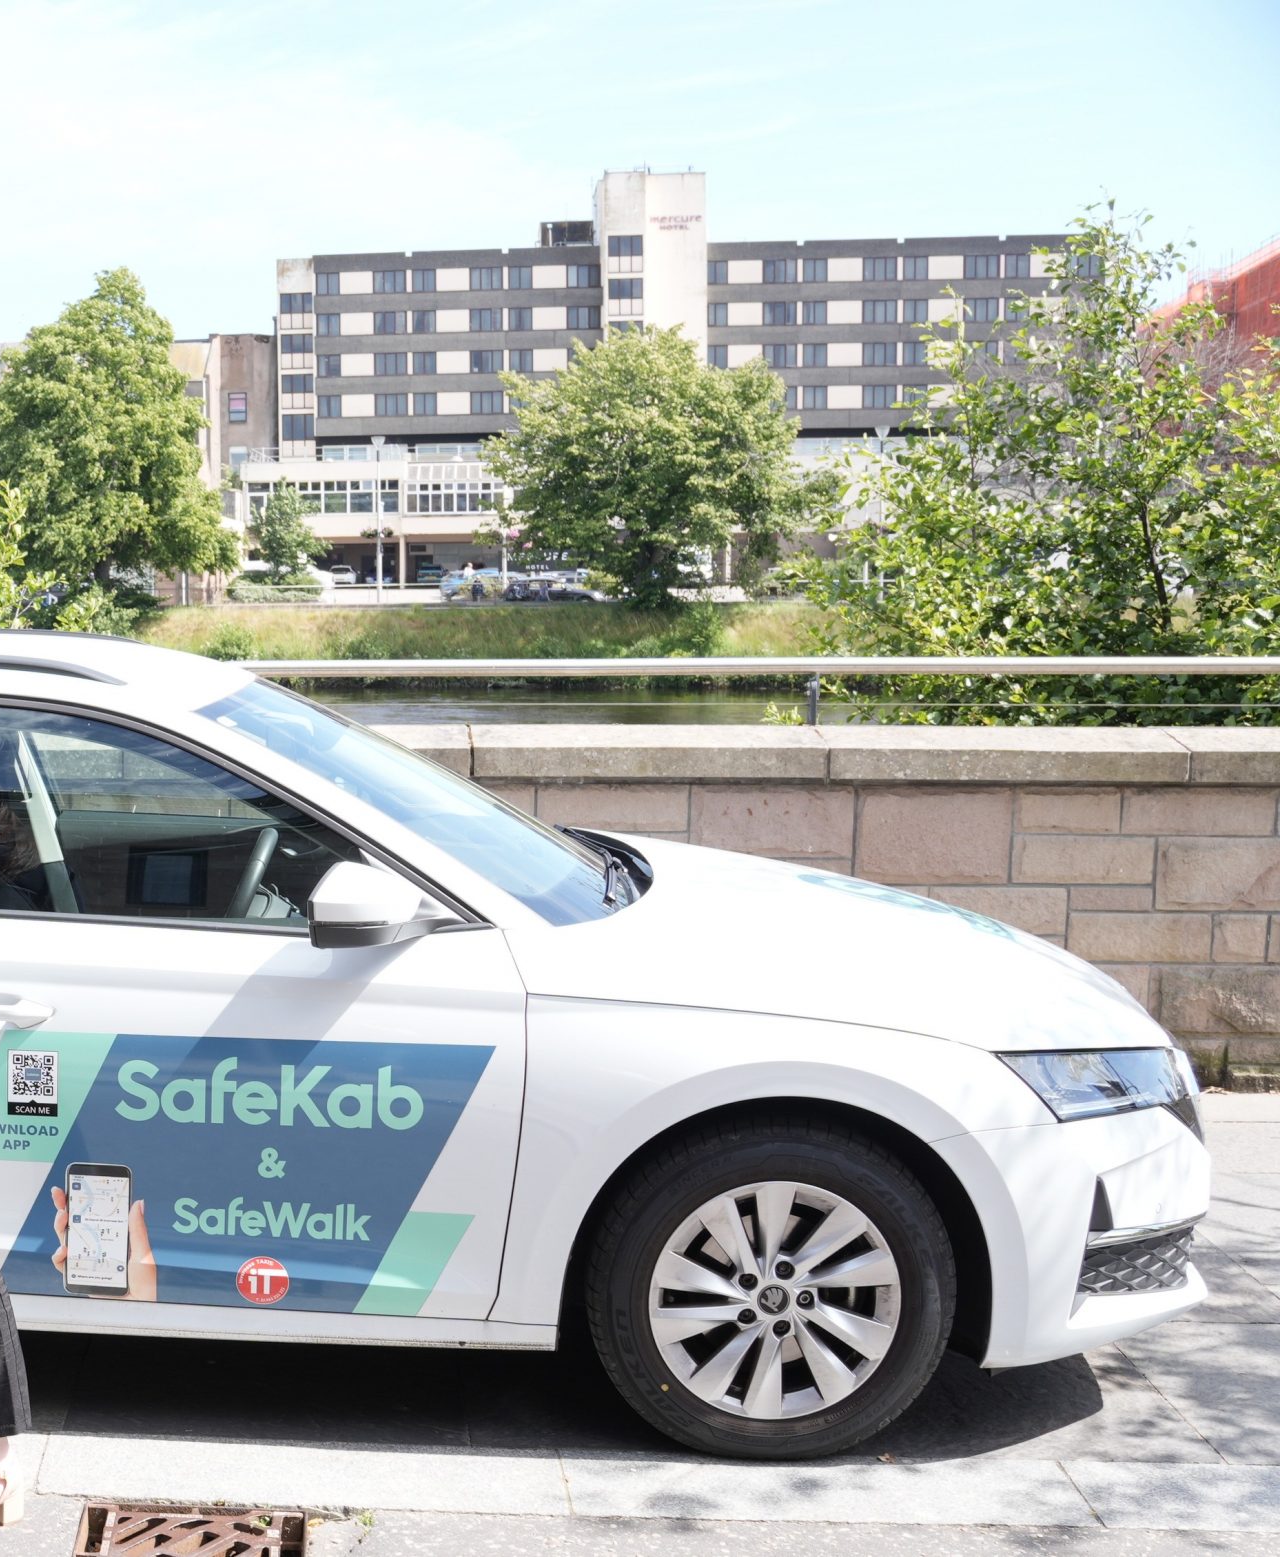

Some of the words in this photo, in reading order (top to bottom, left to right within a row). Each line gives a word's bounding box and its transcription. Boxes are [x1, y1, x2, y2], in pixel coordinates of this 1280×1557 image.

[15, 1105, 36, 1114] SCAN
[115, 1056, 424, 1131] SafeKab
[3, 1140, 31, 1150] APP
[257, 1147, 286, 1179] &
[172, 1196, 371, 1242] SafeWalk
